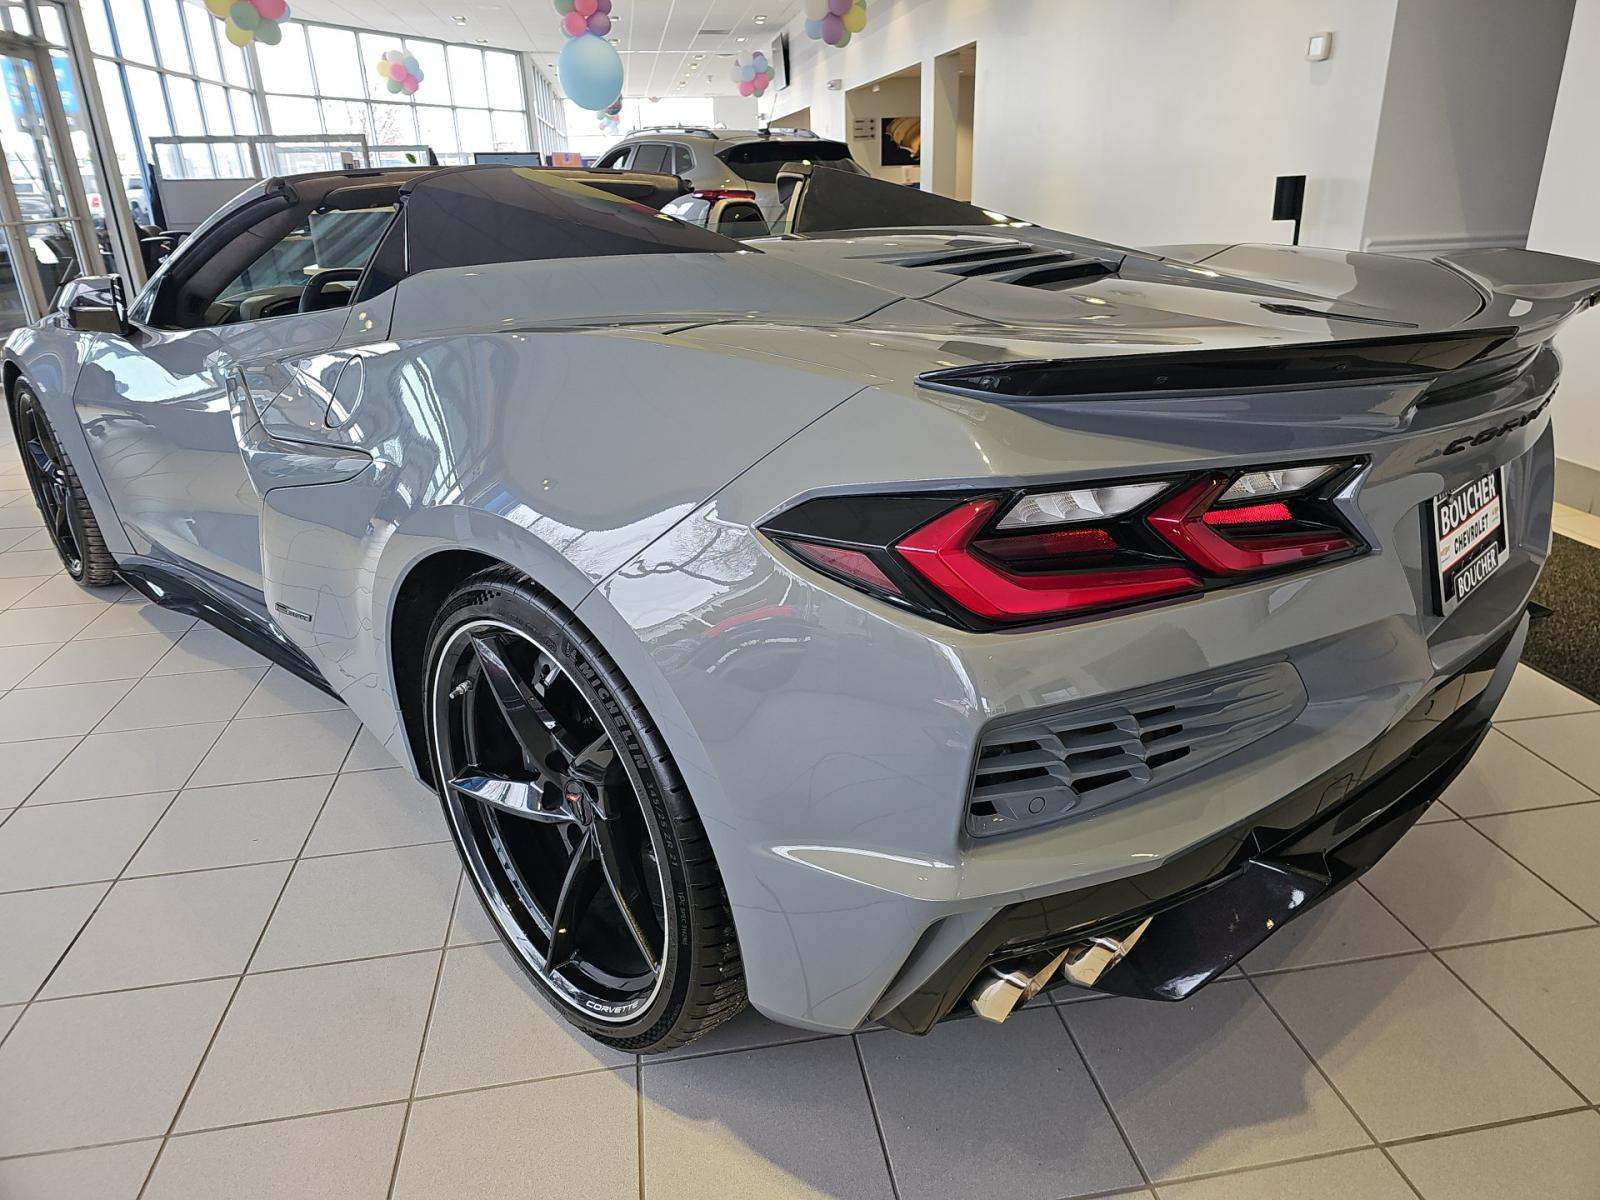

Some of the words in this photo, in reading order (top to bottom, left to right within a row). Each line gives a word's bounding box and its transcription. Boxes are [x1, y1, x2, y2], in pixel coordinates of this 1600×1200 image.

[1442, 382, 1559, 455] CORV
[1440, 473, 1496, 536] BOUCHER
[1454, 513, 1489, 554] CHEVROLET
[1457, 549, 1497, 598] BOUCHER
[578, 661, 648, 769] MICHELIN
[585, 1000, 639, 1014] CORVETTE
